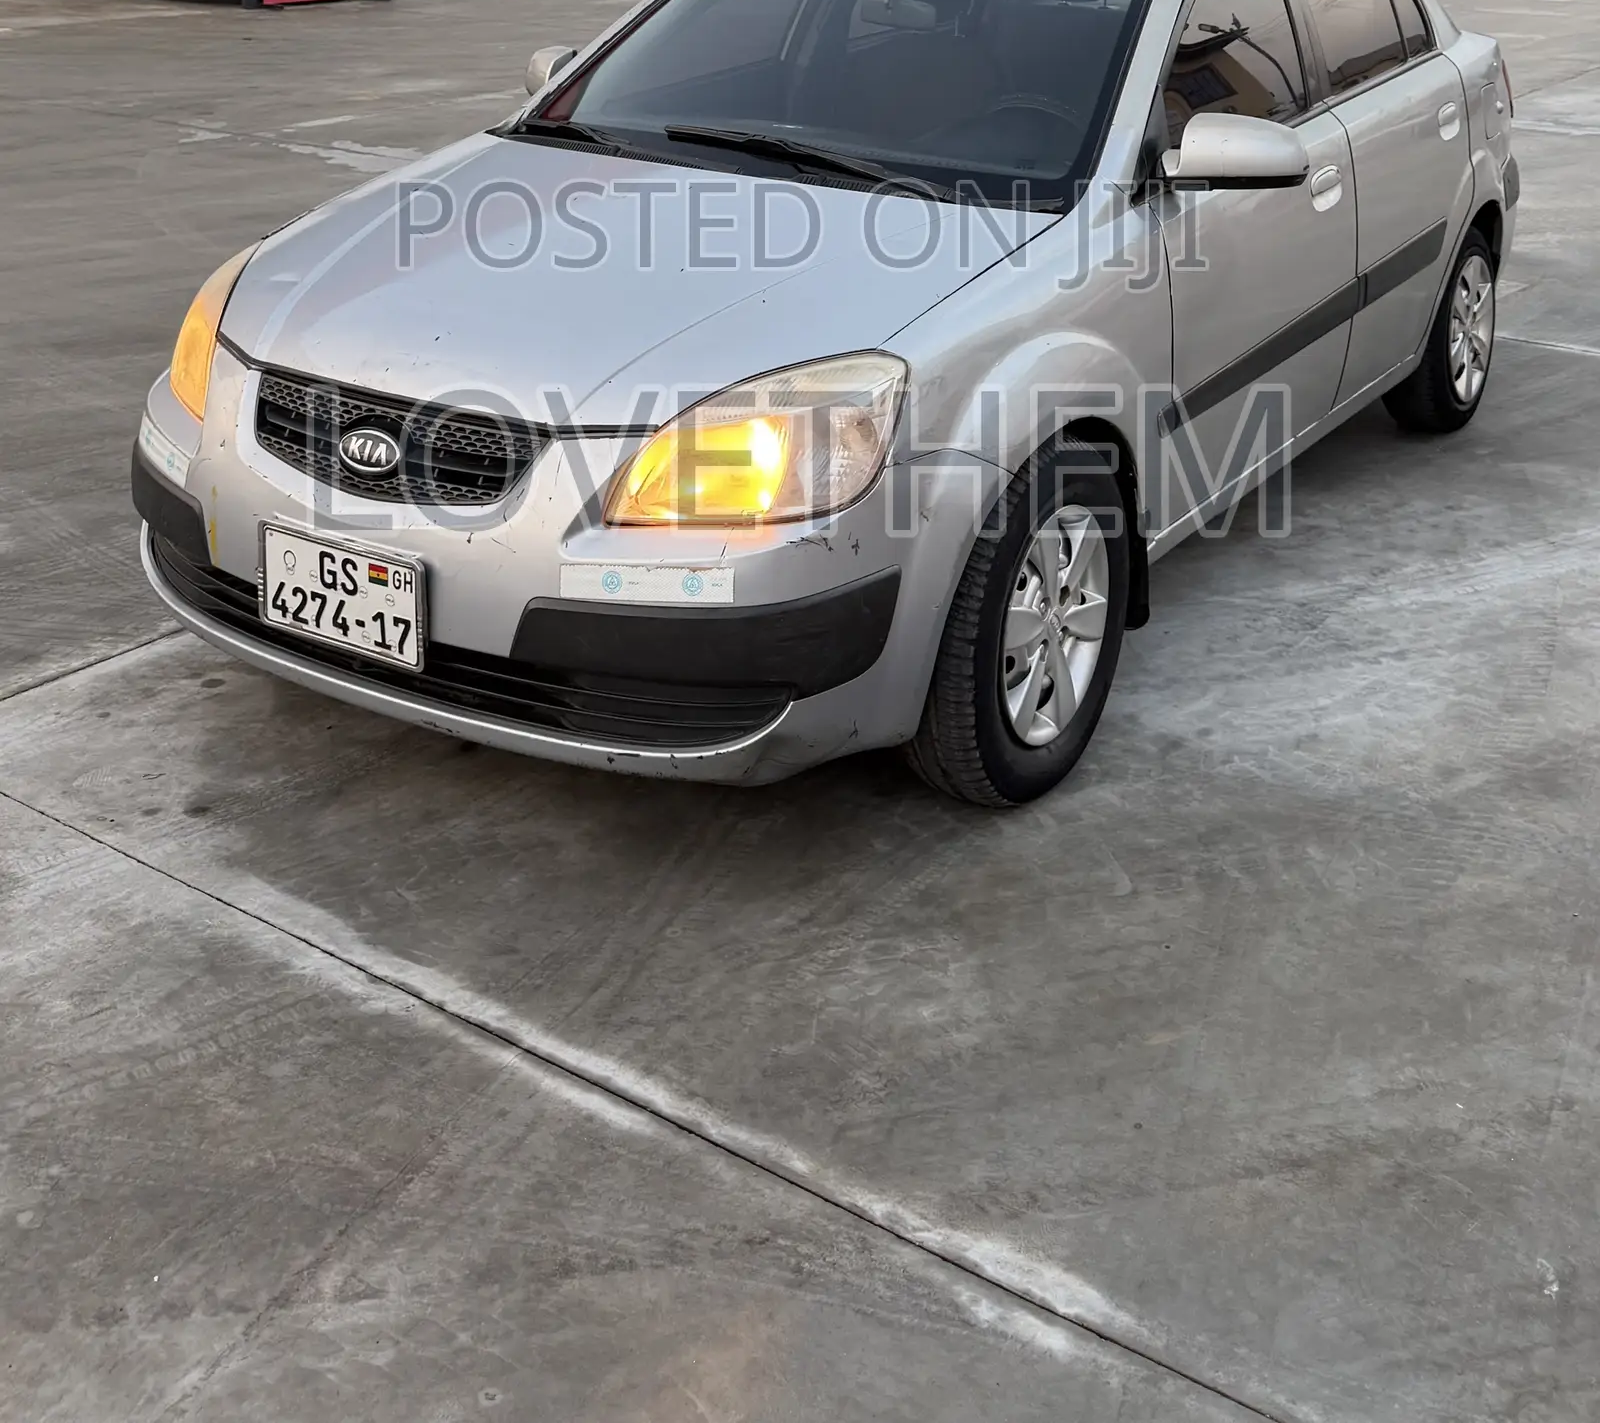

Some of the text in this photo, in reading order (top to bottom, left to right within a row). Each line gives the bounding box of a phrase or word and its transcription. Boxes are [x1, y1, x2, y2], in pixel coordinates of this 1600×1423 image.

[347, 436, 387, 466] KIA
[318, 550, 413, 596] GS GH
[271, 581, 411, 655] 4274-17
